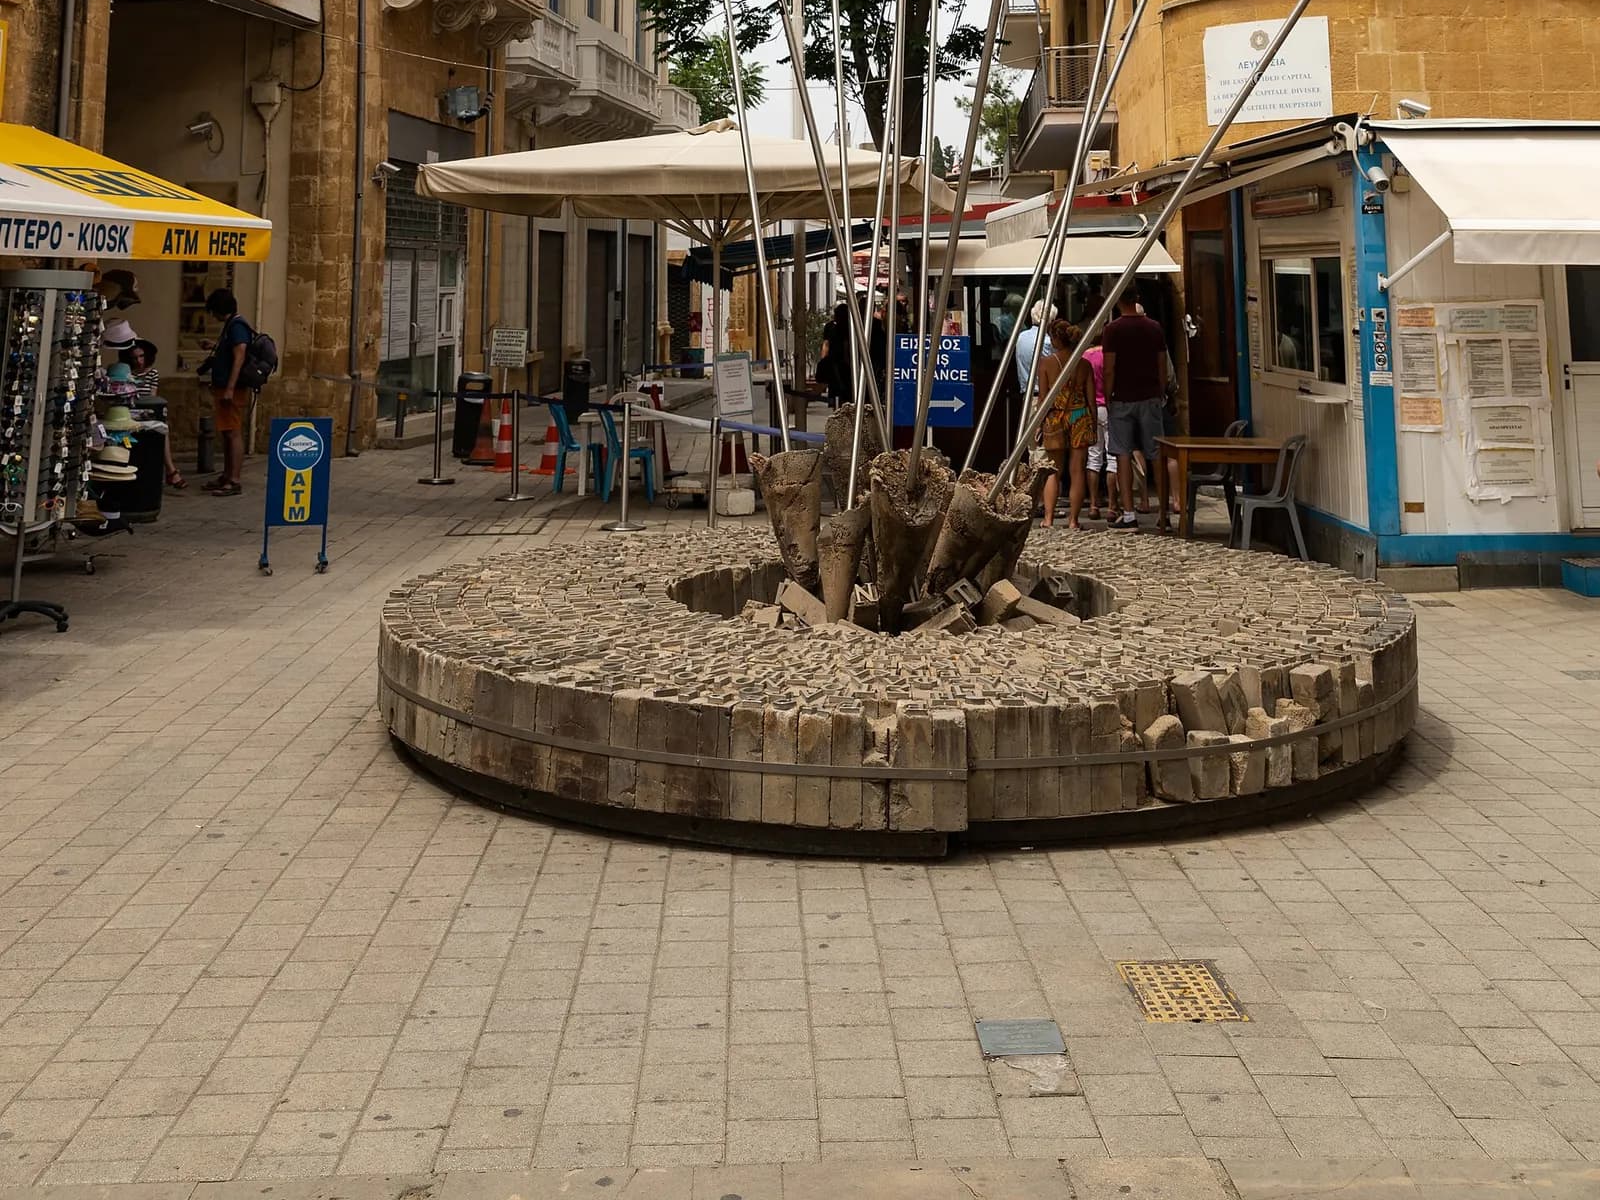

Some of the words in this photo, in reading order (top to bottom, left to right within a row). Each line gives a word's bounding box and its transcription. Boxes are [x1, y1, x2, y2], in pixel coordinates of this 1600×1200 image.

[1238, 58, 1287, 70] ΛΕΥΚΣΙΑ
[1281, 73, 1312, 81] CAPITAL
[1255, 88, 1289, 97] CAPITALE
[1279, 100, 1322, 109] HAUPTSTADT
[78, 222, 130, 253] KIOSK
[162, 228, 199, 255] ATM
[208, 231, 247, 257] HERE
[893, 368, 968, 381] ENTANCE
[288, 472, 306, 520] ATM
